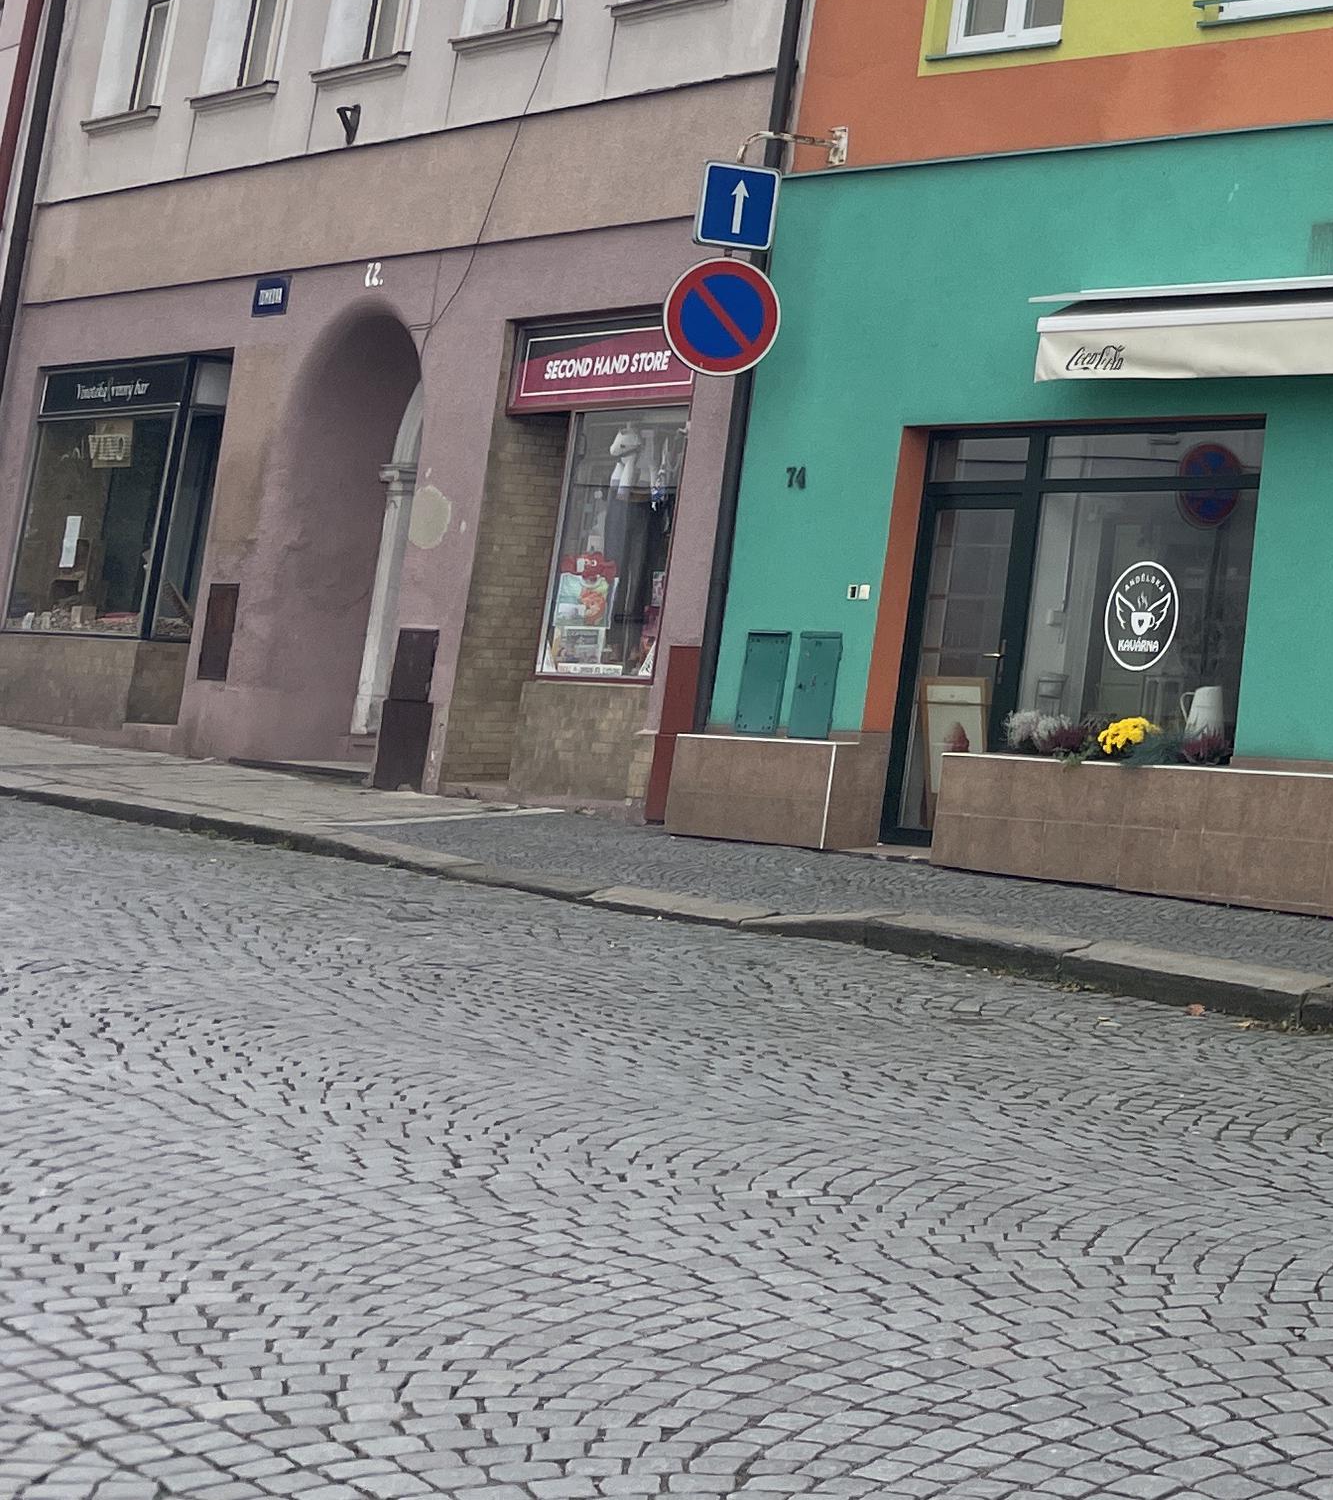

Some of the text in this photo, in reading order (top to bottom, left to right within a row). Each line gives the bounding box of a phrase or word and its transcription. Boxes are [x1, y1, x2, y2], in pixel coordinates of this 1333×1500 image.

[544, 349, 672, 380] SECOND HAND STORE
[785, 466, 807, 490] 74
[1117, 637, 1160, 653] KAVÁRNA
